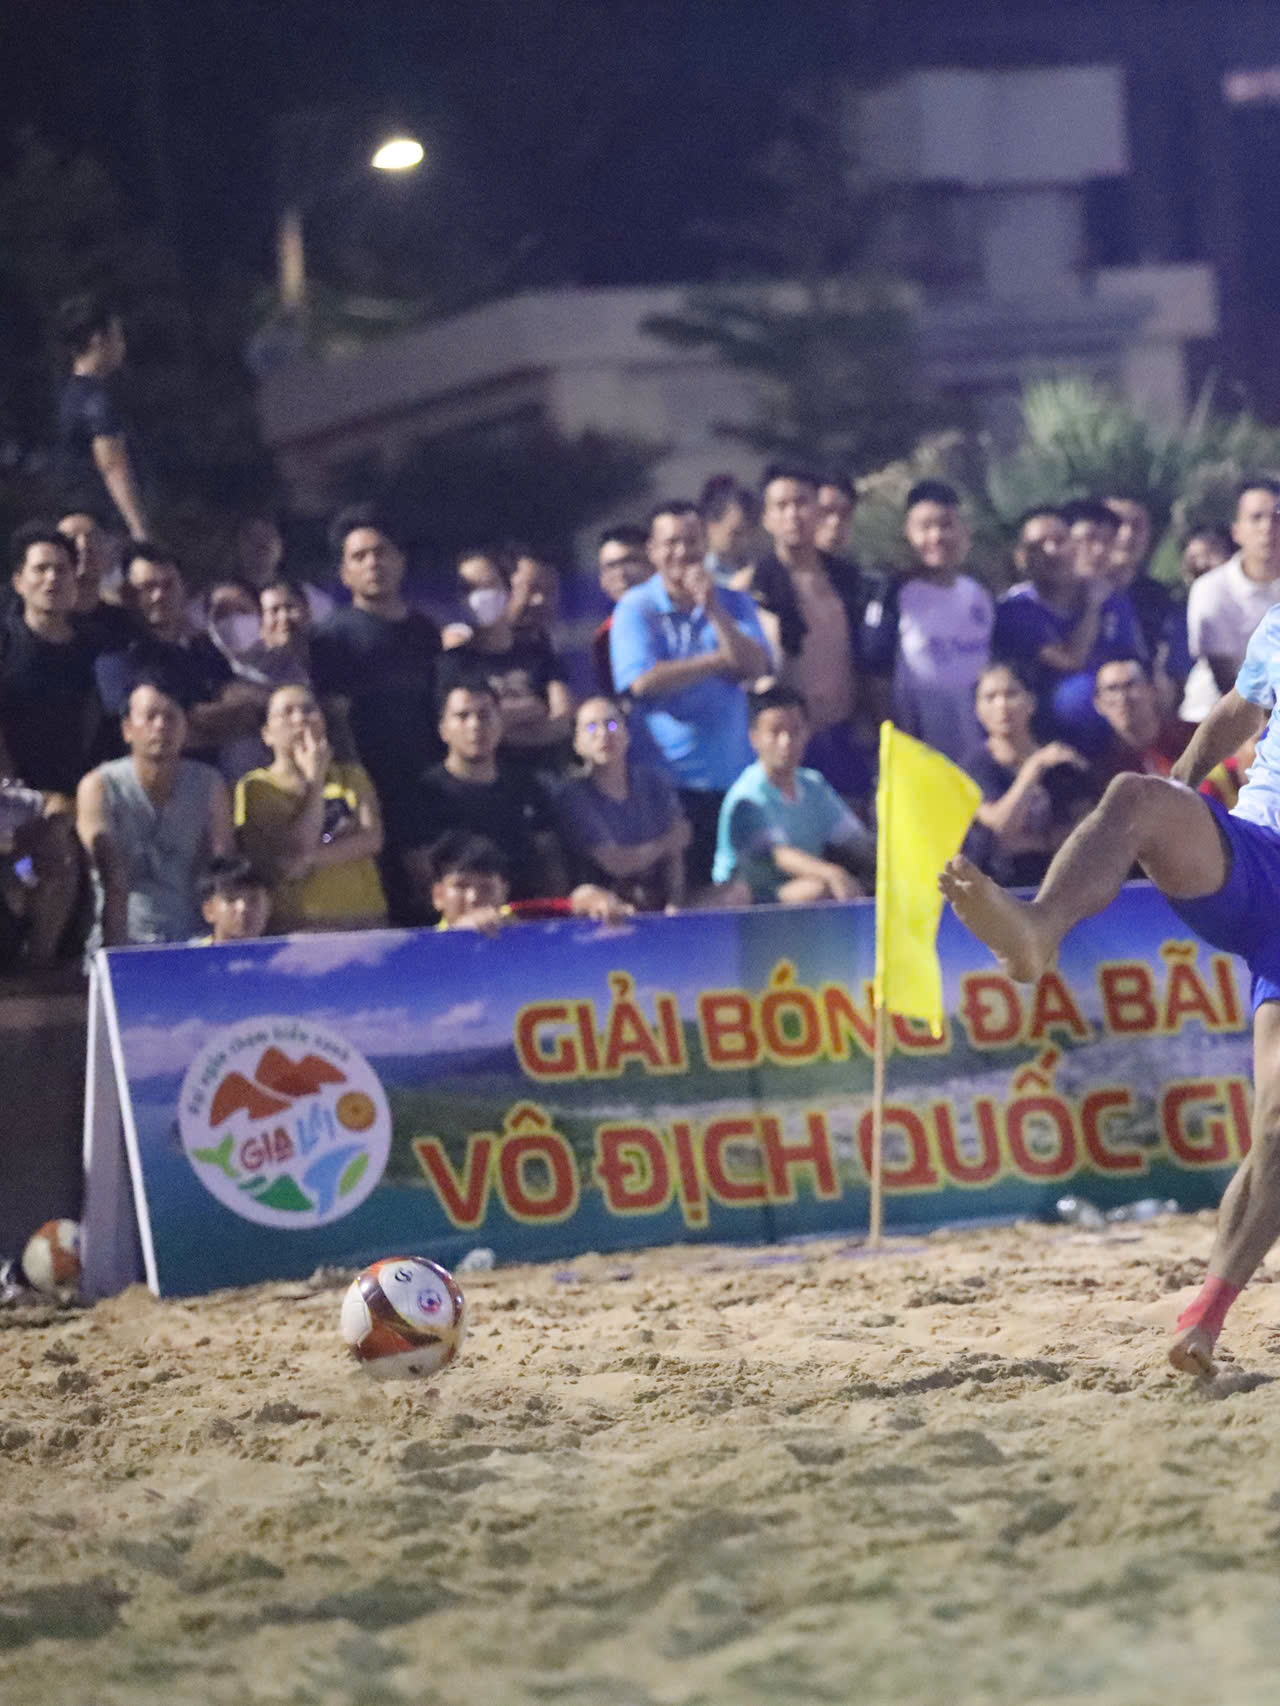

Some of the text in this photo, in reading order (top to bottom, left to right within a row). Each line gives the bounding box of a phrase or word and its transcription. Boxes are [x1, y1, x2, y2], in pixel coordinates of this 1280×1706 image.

[515, 970, 688, 1081] GIẢI
[1098, 938, 1246, 1034] BÃI
[412, 1100, 580, 1229] VÔ
[595, 1110, 842, 1229] ĐỊCH
[856, 1041, 1150, 1194] QUỐC
